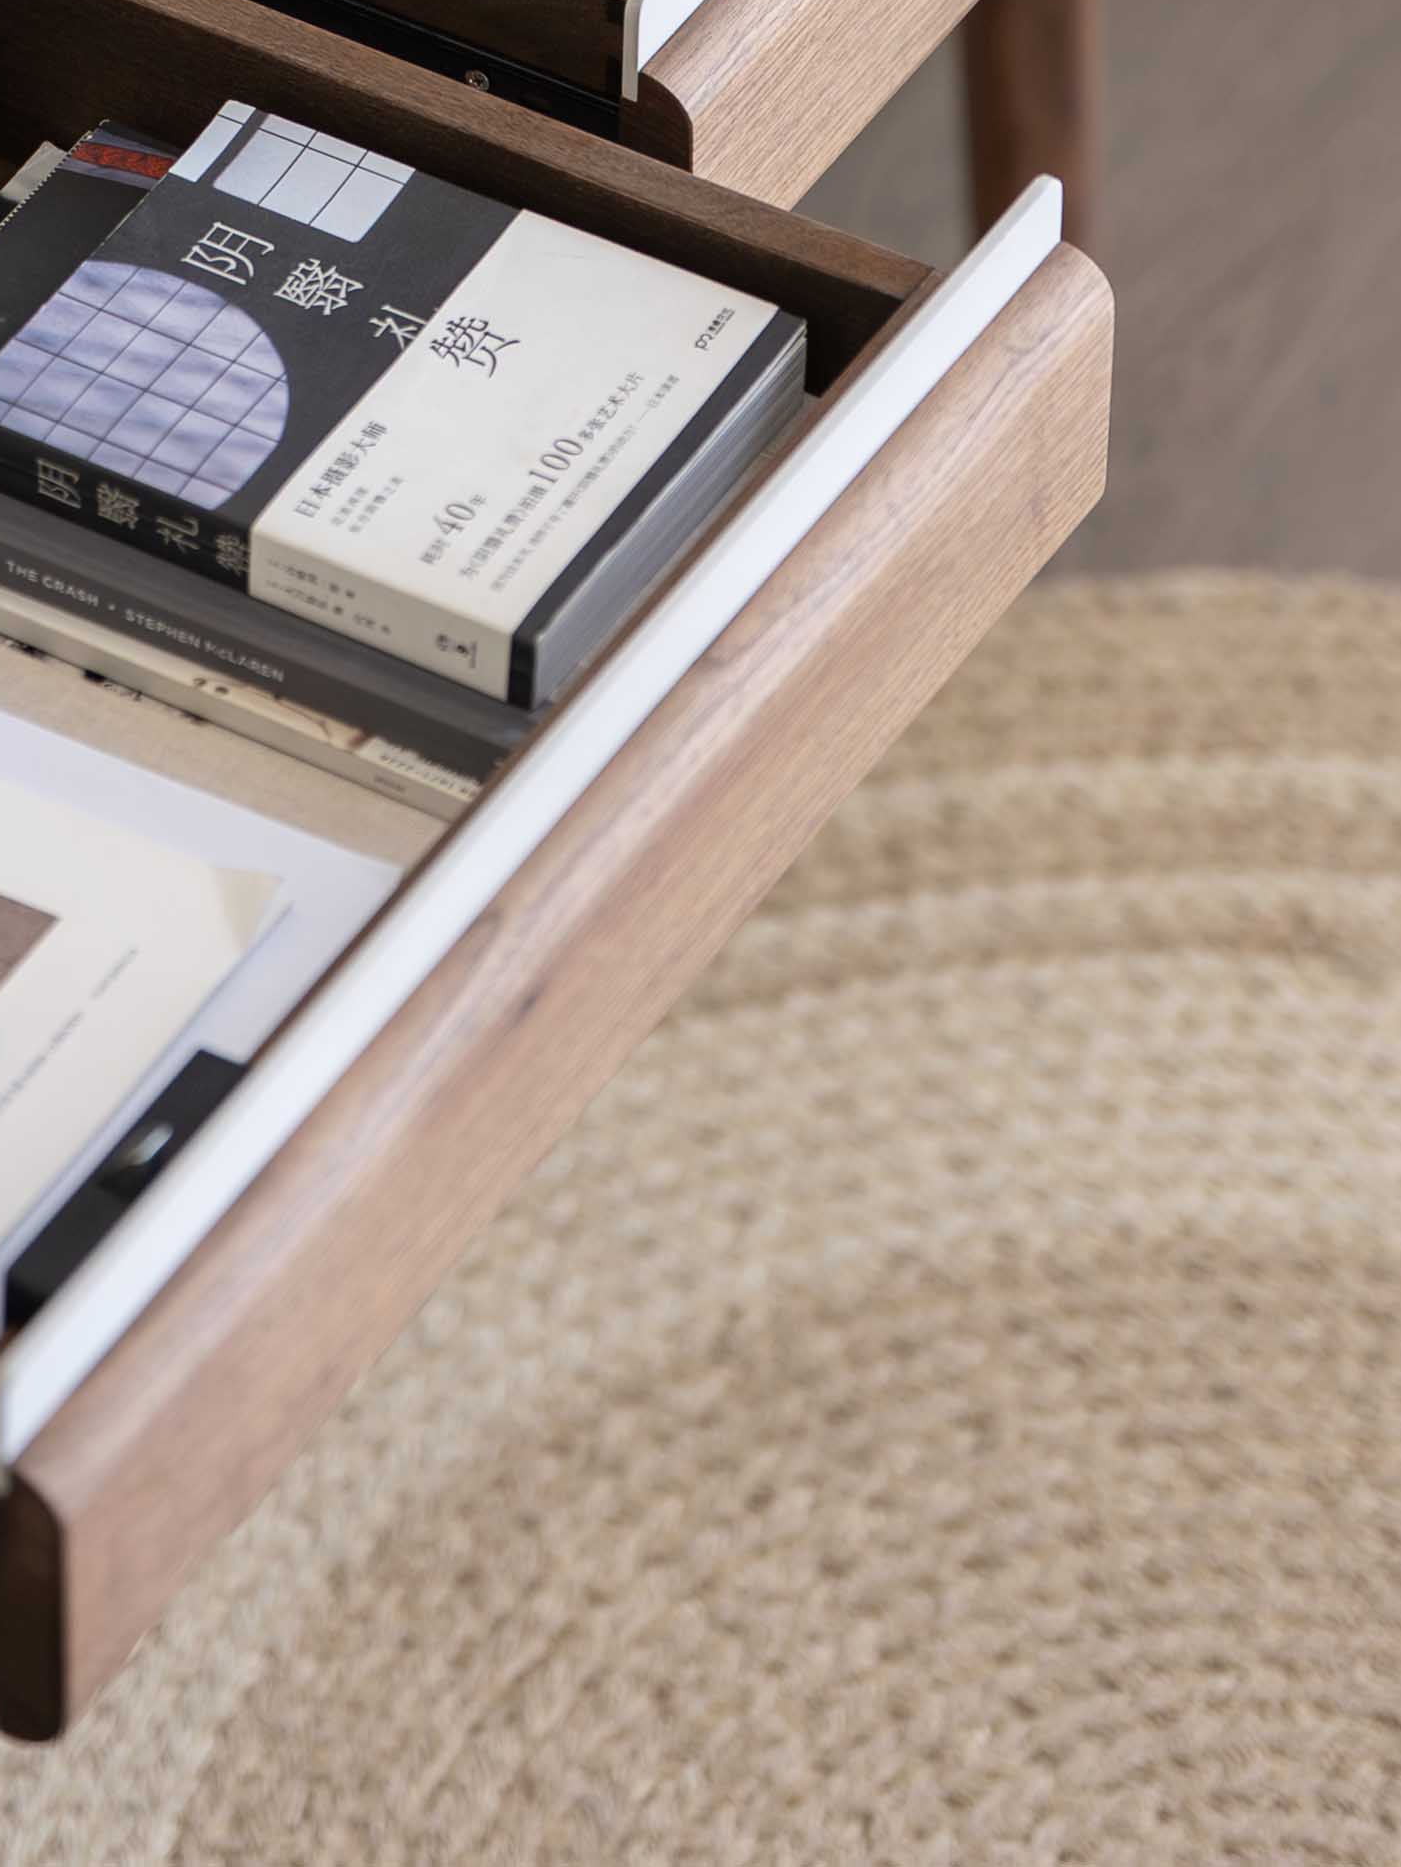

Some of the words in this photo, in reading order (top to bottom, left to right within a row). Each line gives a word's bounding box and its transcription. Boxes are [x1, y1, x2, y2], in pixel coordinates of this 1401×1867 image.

[6, 560, 38, 583] THE
[42, 576, 99, 607] CRASH
[125, 609, 200, 648] STEPHEN
